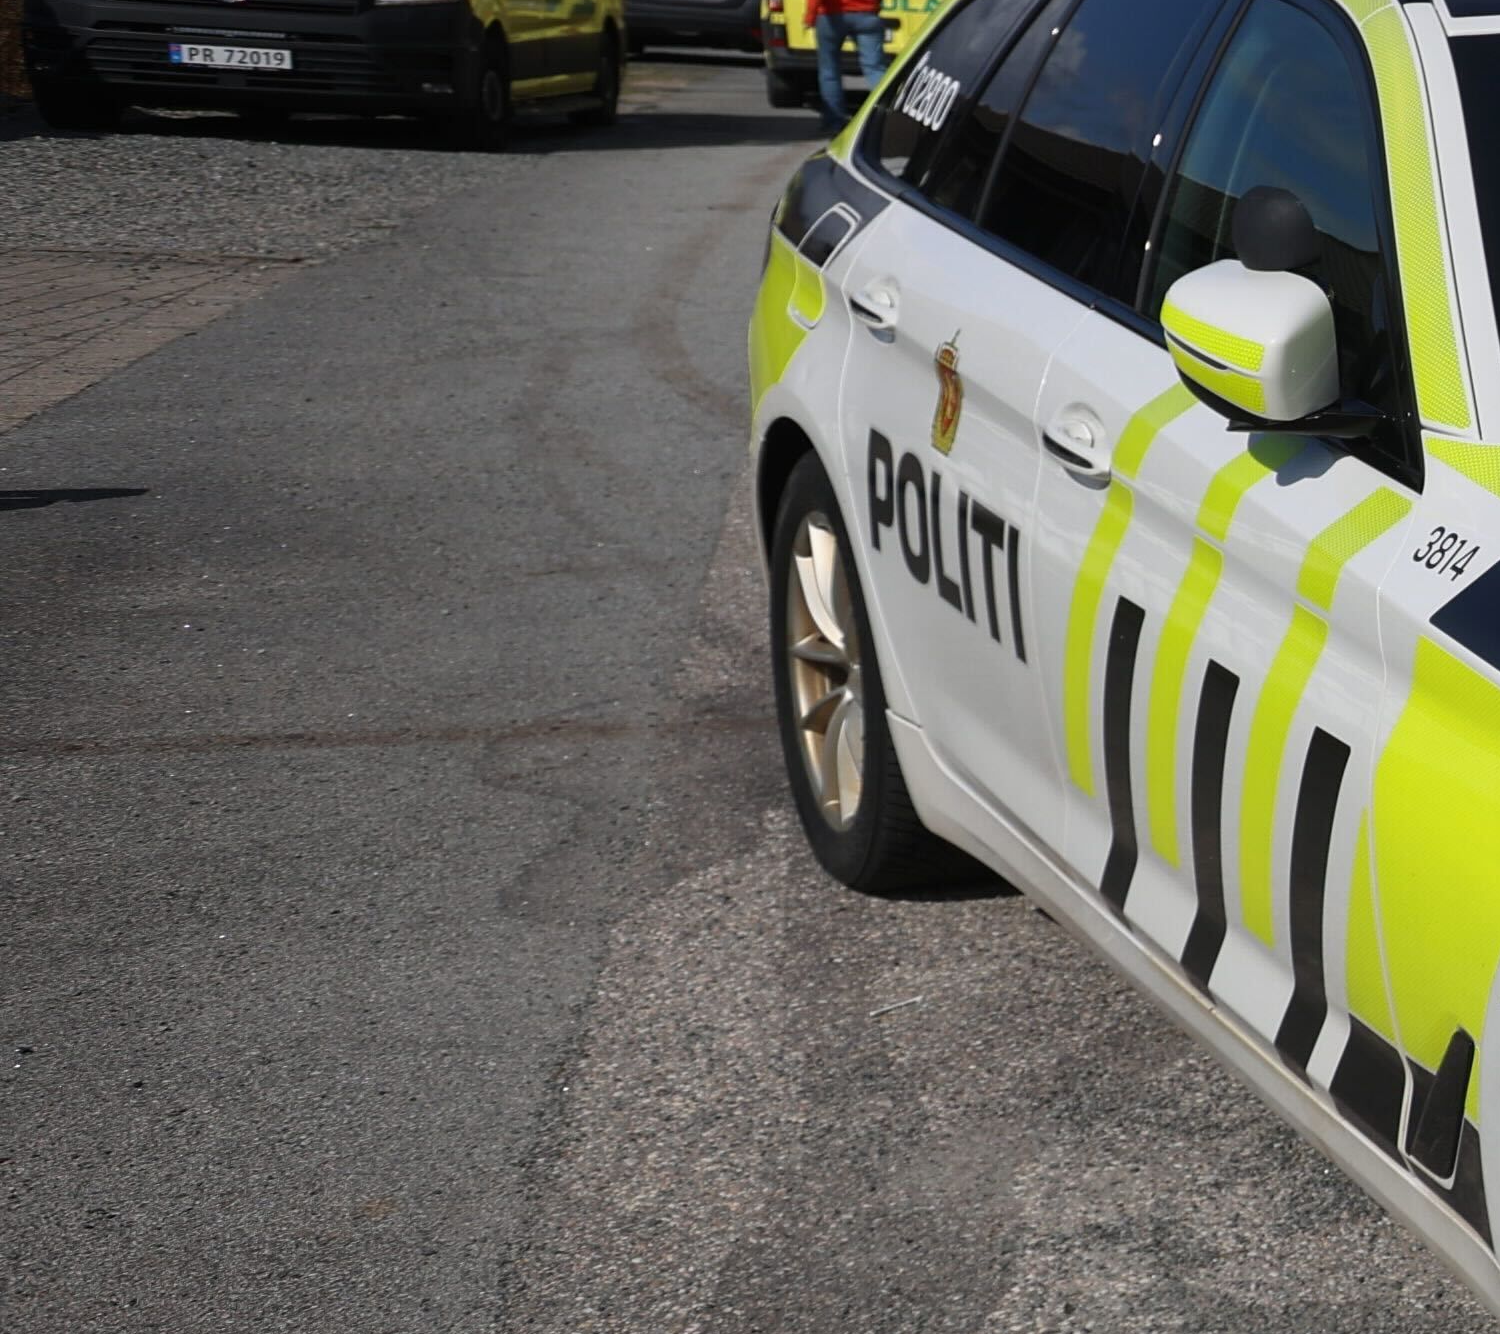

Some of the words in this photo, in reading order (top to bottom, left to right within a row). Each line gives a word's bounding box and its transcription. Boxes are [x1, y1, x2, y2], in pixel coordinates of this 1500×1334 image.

[187, 47, 215, 63] PR
[223, 49, 286, 66] 72019
[902, 65, 960, 131] 02800
[868, 427, 1027, 665] POLITI
[1413, 526, 1480, 581] 3814
